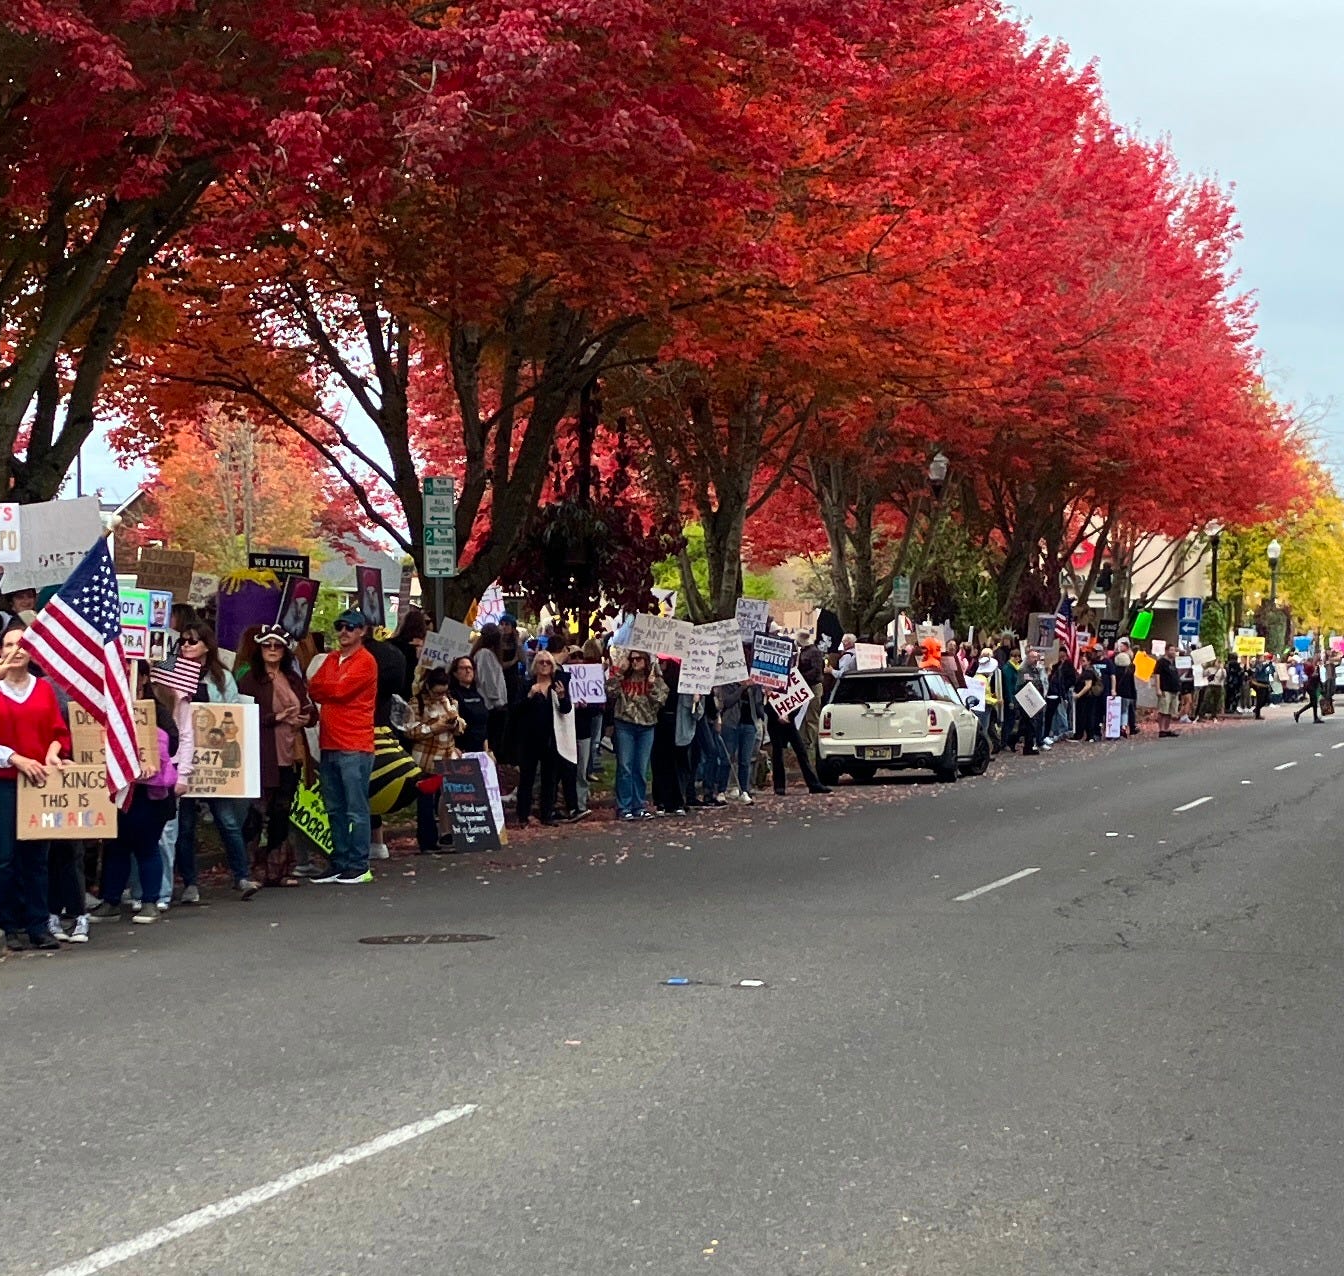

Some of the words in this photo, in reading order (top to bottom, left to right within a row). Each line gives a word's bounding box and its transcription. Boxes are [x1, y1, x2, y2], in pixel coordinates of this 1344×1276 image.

[425, 530, 433, 543] 2
[269, 558, 304, 568] BELIEVE
[136, 603, 144, 615] A
[646, 620, 676, 629] TRUMP
[137, 634, 144, 646] A
[753, 650, 790, 667] PROTECT
[569, 666, 586, 680] NO
[775, 688, 809, 716] HEALS
[62, 771, 107, 789] KINGS
[41, 794, 68, 808] THIS
[78, 793, 89, 807] IS
[28, 811, 106, 829] AMERICA
